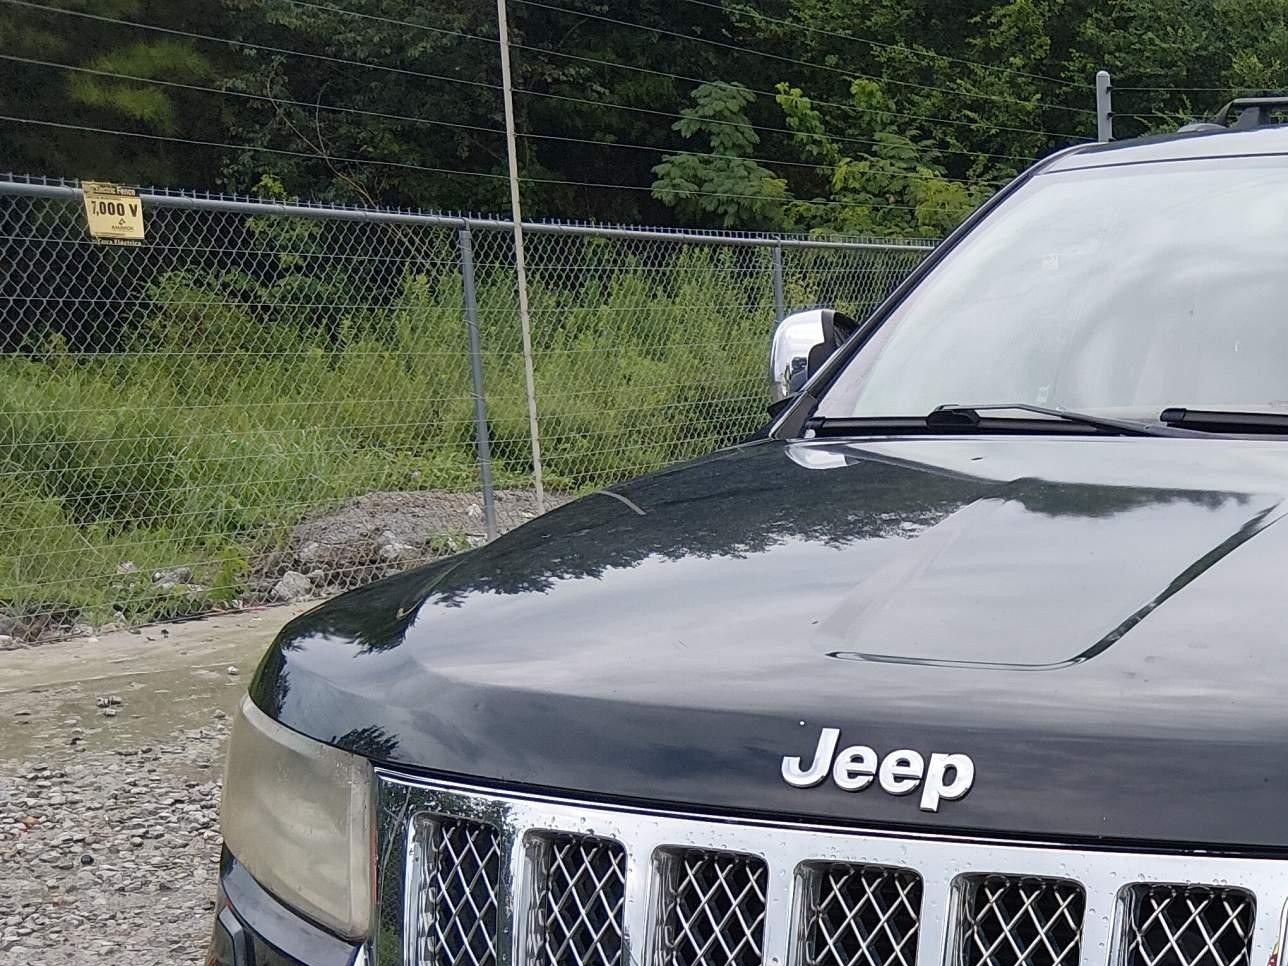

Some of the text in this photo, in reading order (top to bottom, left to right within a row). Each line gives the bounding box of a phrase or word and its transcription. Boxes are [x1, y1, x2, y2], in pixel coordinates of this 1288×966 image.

[91, 201, 138, 218] 7,000 V
[781, 727, 976, 813] Jeep
